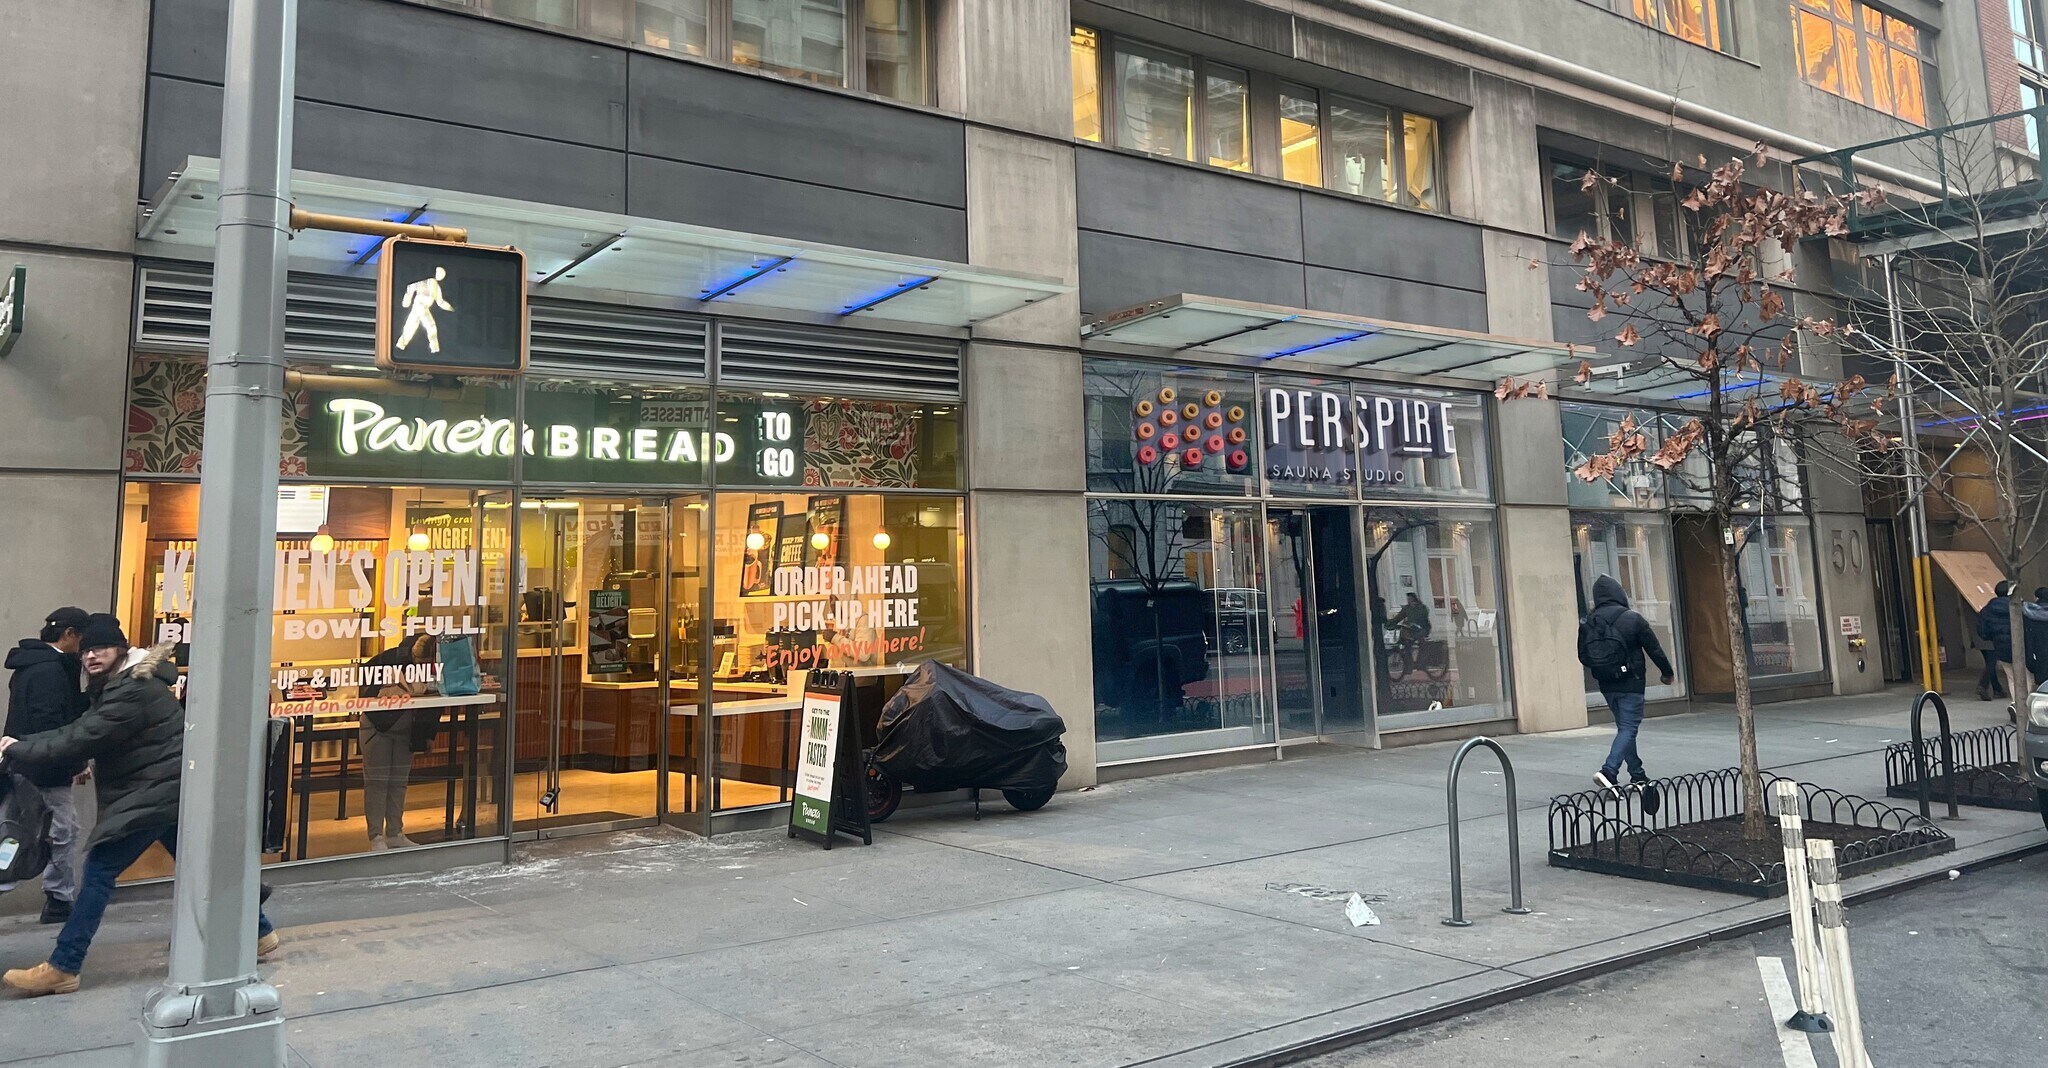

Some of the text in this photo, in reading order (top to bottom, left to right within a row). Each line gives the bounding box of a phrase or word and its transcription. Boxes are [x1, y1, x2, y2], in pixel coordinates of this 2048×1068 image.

[328, 398, 735, 462] Panera BREAD
[762, 411, 791, 441] TO
[1269, 388, 1457, 453] PERSPIRE
[763, 447, 794, 477] GO
[1273, 464, 1332, 479] SAUNA
[780, 544, 803, 563] COFFEE
[1831, 529, 1864, 576] 50
[384, 549, 487, 608] OPEN.
[774, 565, 918, 596] ORDER AHEAD
[596, 596, 622, 608] DELIGHT
[773, 598, 919, 633] PICK-UP HERE
[284, 617, 400, 641] BOWLS
[406, 615, 487, 637] FULL.
[765, 626, 926, 671] Enjoy anywhere!
[310, 668, 328, 688] &
[330, 664, 402, 687] DELIVERY
[405, 662, 445, 683] ONLY
[272, 693, 416, 716] head on our app.
[810, 716, 829, 741] MMM
[806, 741, 828, 768] FASTER
[802, 801, 821, 819] Panera
